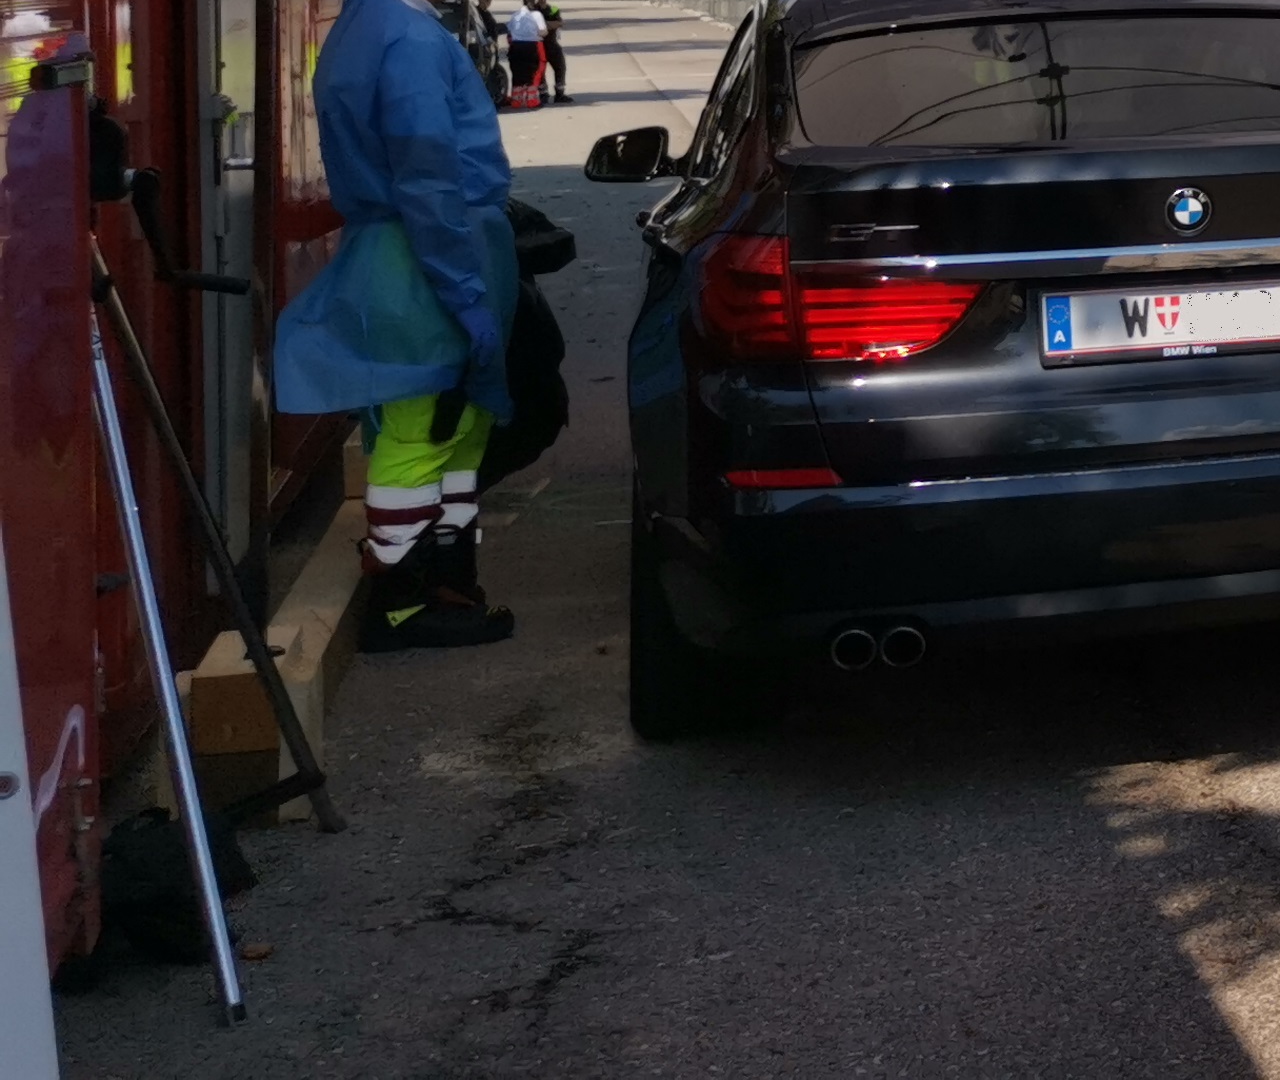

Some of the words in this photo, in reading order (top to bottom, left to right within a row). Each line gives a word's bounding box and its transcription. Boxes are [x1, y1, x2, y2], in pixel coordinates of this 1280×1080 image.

[1119, 297, 1150, 338] W
[1053, 330, 1066, 344] A
[1162, 346, 1190, 358] BMW
